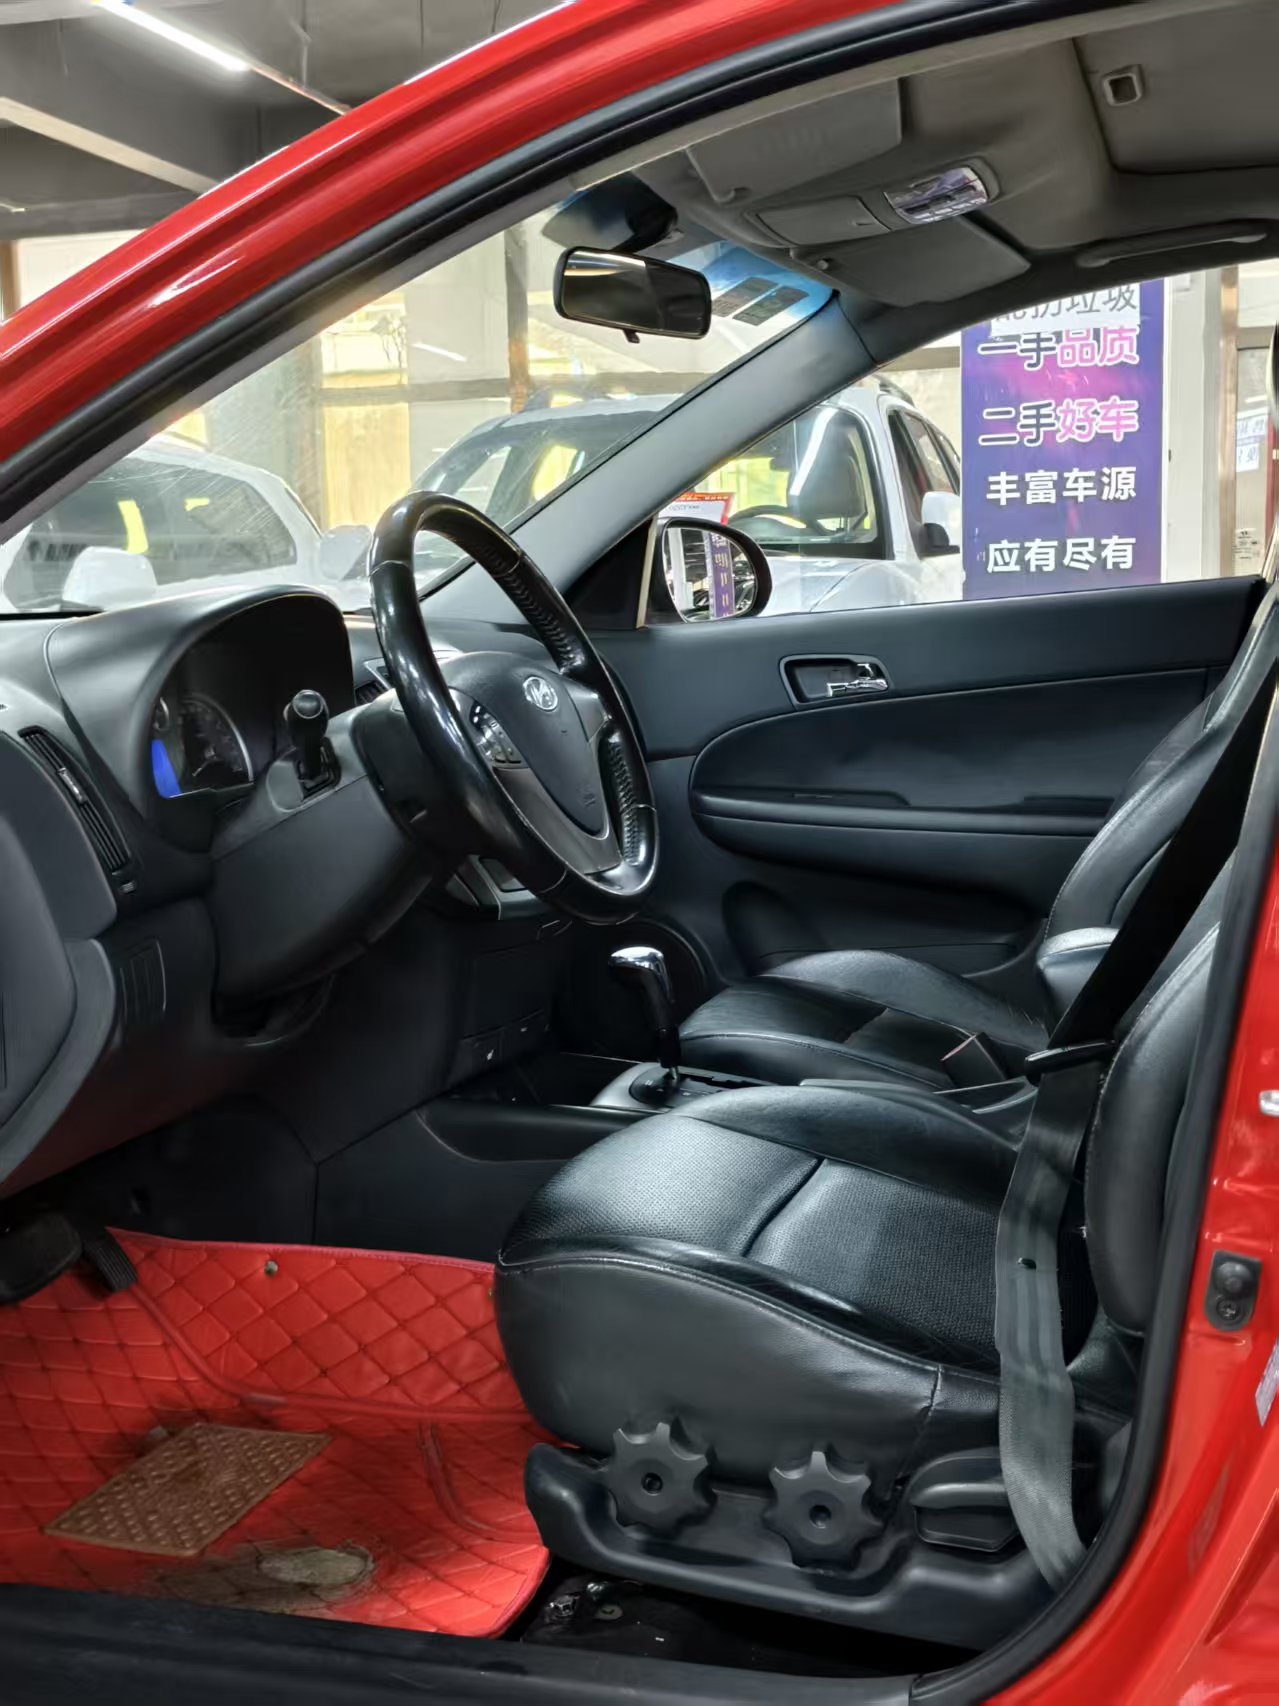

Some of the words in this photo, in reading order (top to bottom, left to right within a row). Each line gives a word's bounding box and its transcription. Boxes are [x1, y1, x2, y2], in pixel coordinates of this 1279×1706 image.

[995, 284, 1137, 320] 扔垃圾
[979, 326, 1139, 369] 一手品质
[979, 396, 1139, 446] 二手好车
[986, 467, 1136, 506] 丰富车源
[987, 535, 1136, 573] 应有尽有
